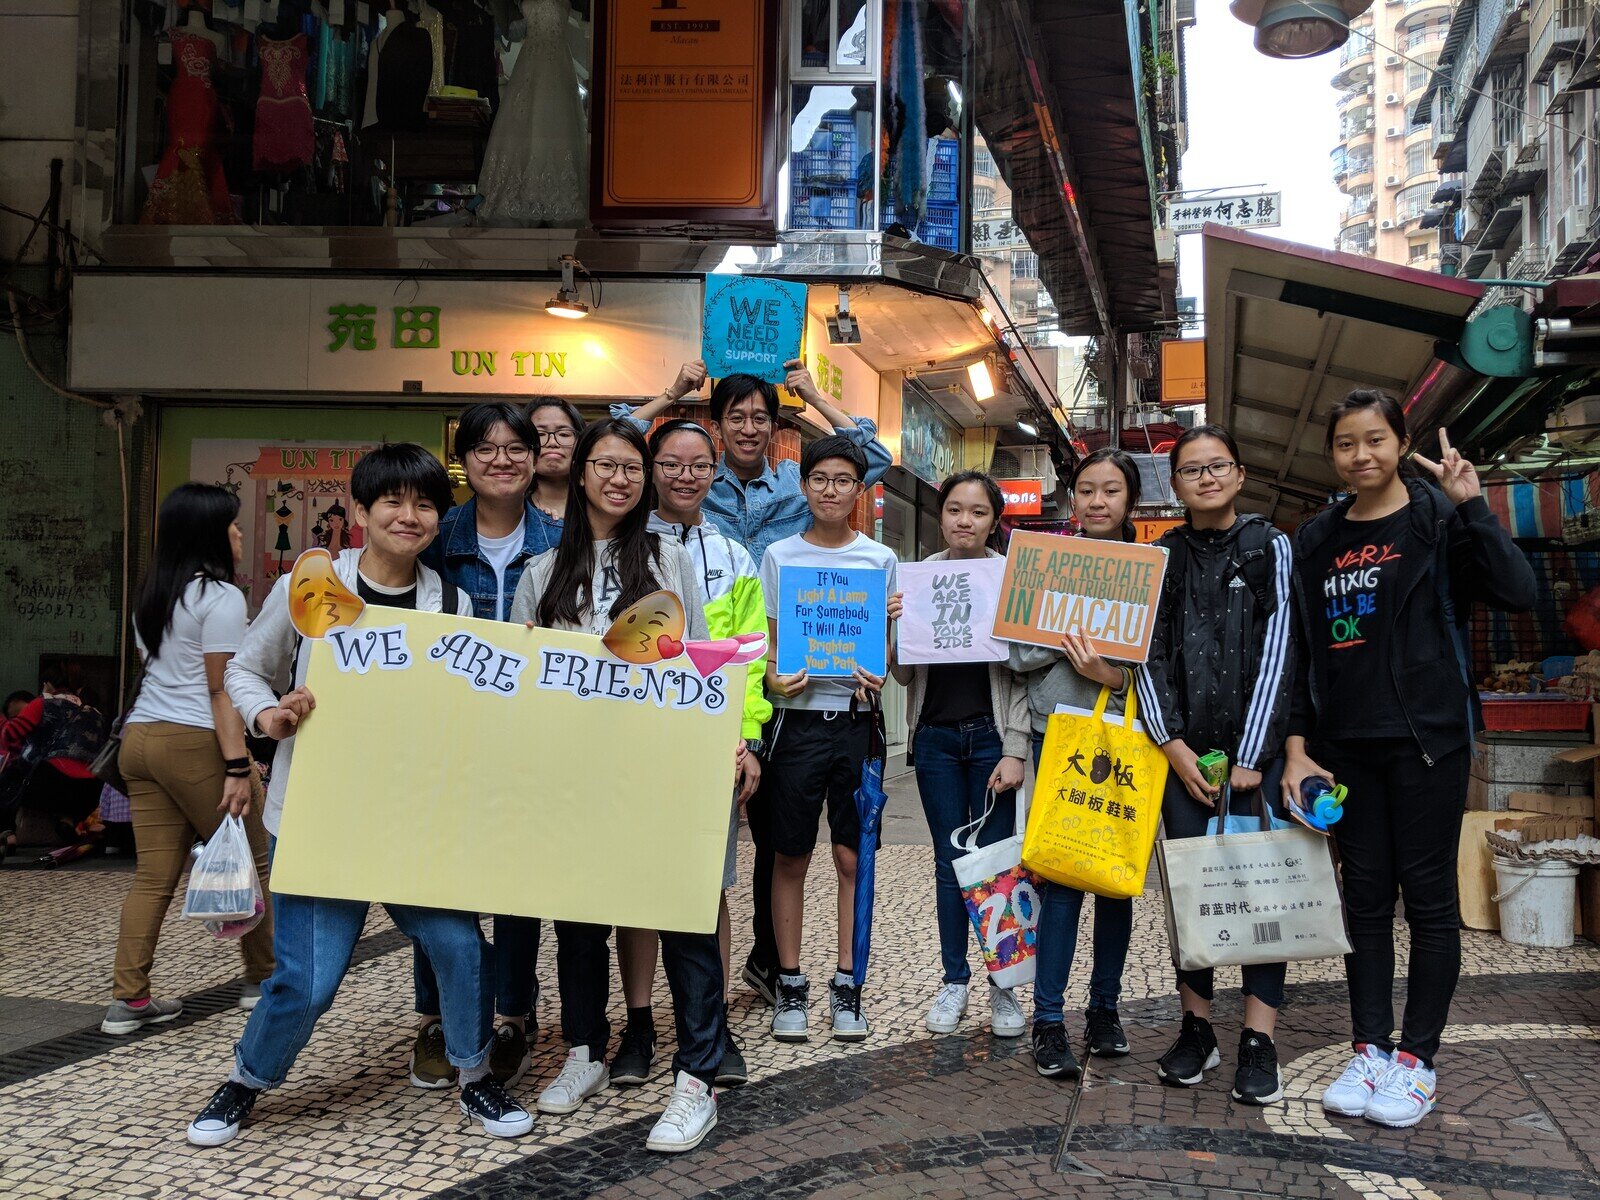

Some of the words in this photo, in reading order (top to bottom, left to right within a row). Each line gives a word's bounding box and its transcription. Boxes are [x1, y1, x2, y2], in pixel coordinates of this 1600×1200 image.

[620, 73, 749, 86] 法利洋服行有限公司
[1172, 206, 1213, 220] 牙科醫師
[1214, 196, 1275, 220] 何志勝
[730, 296, 781, 326] WE
[328, 303, 441, 351] 苑田
[727, 322, 779, 342] NEED
[726, 338, 756, 351] YOU
[761, 342, 779, 354] TO
[451, 350, 498, 376] UN
[511, 351, 567, 377] TIN
[725, 350, 778, 364] SUPPORT
[280, 448, 318, 470] UN
[329, 449, 370, 470] TI
[1329, 542, 1401, 571] VERY
[707, 569, 724, 577] NIKE
[1015, 546, 1043, 572] WE
[1045, 550, 1155, 588] APPRECIATE
[817, 572, 828, 586] If
[831, 572, 849, 586] You
[932, 572, 970, 589] WE
[1012, 568, 1046, 590] YOUR
[1046, 574, 1149, 606] CONTRIBUTION
[797, 588, 824, 604] Light
[828, 588, 836, 603] A
[840, 591, 867, 604] Lamp
[932, 589, 971, 603] ARE
[1356, 593, 1376, 615] BE
[796, 605, 813, 618] For
[817, 605, 869, 622] Somebody
[932, 603, 972, 626] IN
[1004, 587, 1035, 626] IN
[1041, 593, 1144, 644] MACAU
[802, 622, 812, 636] It
[816, 622, 834, 636] Will
[839, 622, 862, 636] Also
[933, 625, 973, 638] YOUR
[1332, 615, 1361, 641] OK
[808, 637, 855, 655] Brighten
[933, 636, 972, 649] SIDE
[329, 630, 408, 667] WE
[430, 634, 521, 692] ARE
[541, 651, 725, 709] FRIENDS
[805, 655, 829, 669] Your
[833, 655, 858, 670] Path
[1055, 786, 1137, 822] 大腳板鞋業
[1199, 901, 1251, 916] 蔚蓝时代
